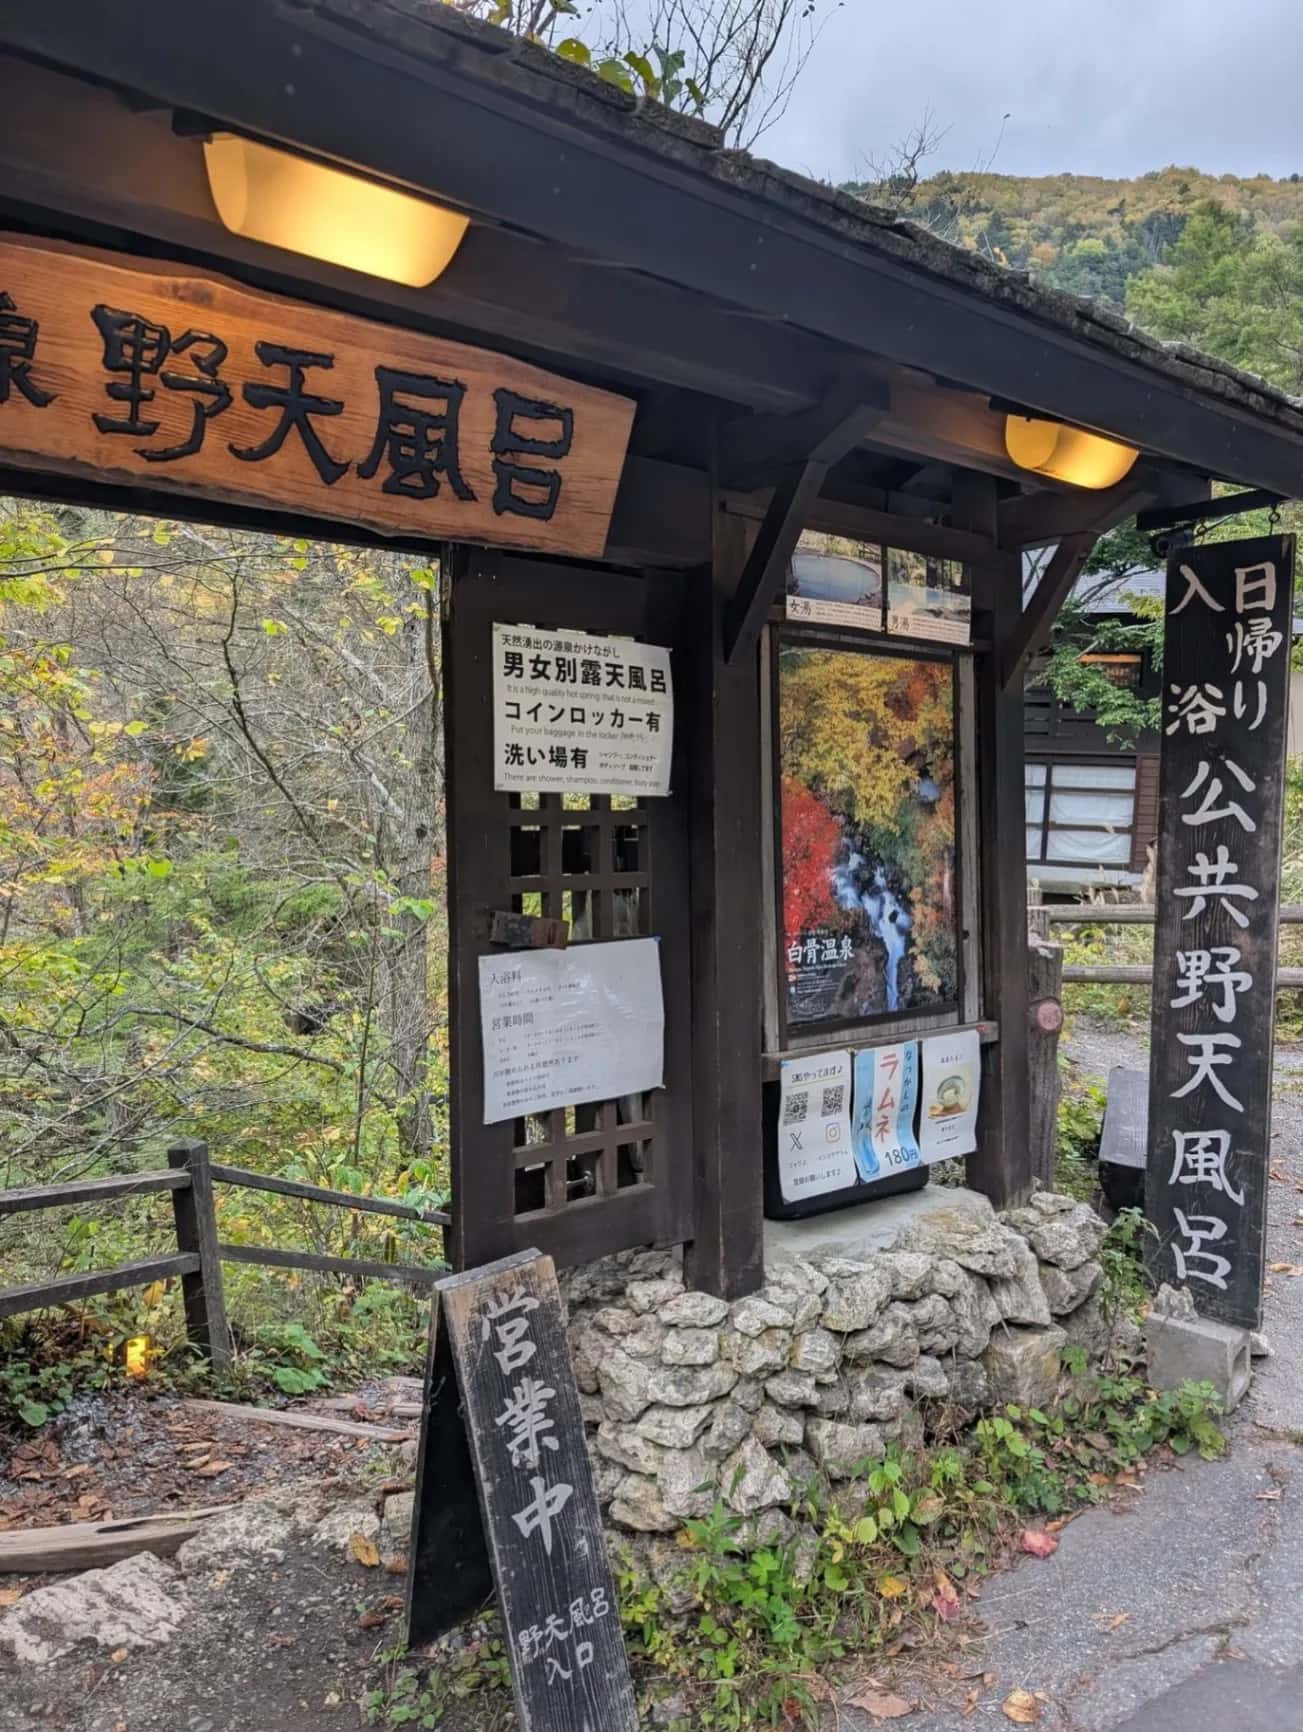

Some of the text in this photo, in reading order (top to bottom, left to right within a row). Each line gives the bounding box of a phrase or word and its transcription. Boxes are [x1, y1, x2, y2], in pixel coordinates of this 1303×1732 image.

[90, 303, 574, 521] 野天風呂
[503, 651, 667, 694] 男女別露天風呂
[1165, 563, 1228, 736] 入浴
[1226, 560, 1284, 731] 日帰り
[504, 701, 661, 733] コインロッカー有
[504, 743, 589, 770] 洗い場有
[787, 934, 857, 965] 白骨温泉
[1168, 759, 1260, 1291] 公共野天風呂
[874, 1053, 899, 1143] ラムネ
[481, 1285, 573, 1556] 営業中
[518, 1587, 609, 1659] 野天風呂
[547, 1641, 594, 1686] 入口
